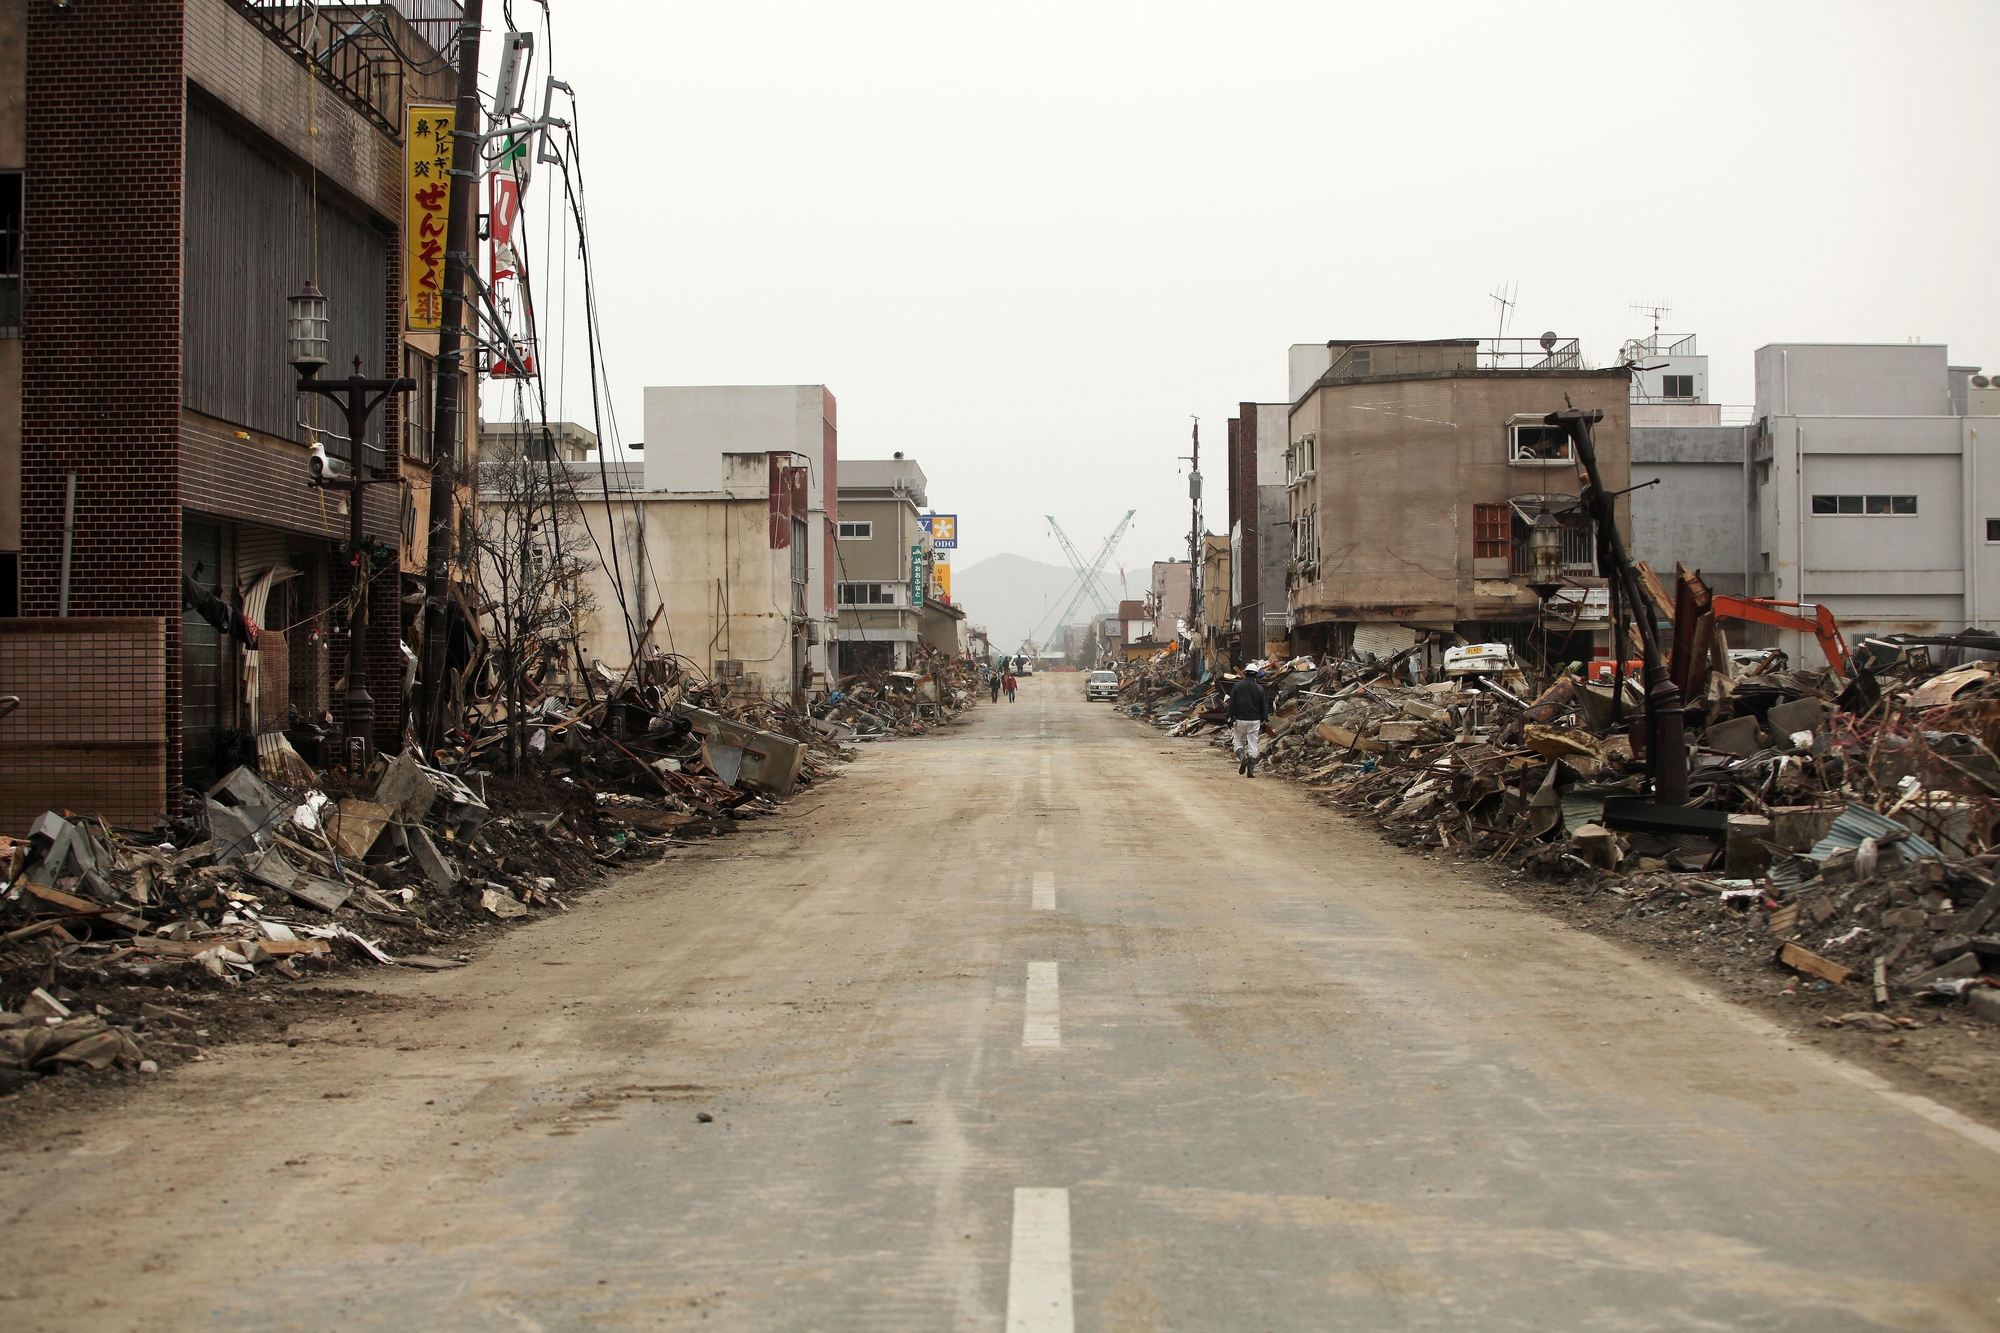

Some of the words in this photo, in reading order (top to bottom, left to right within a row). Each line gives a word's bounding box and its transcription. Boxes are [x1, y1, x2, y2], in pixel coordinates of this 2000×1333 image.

[413, 118, 431, 178] 鼻炎
[434, 117, 450, 179] アレルギー
